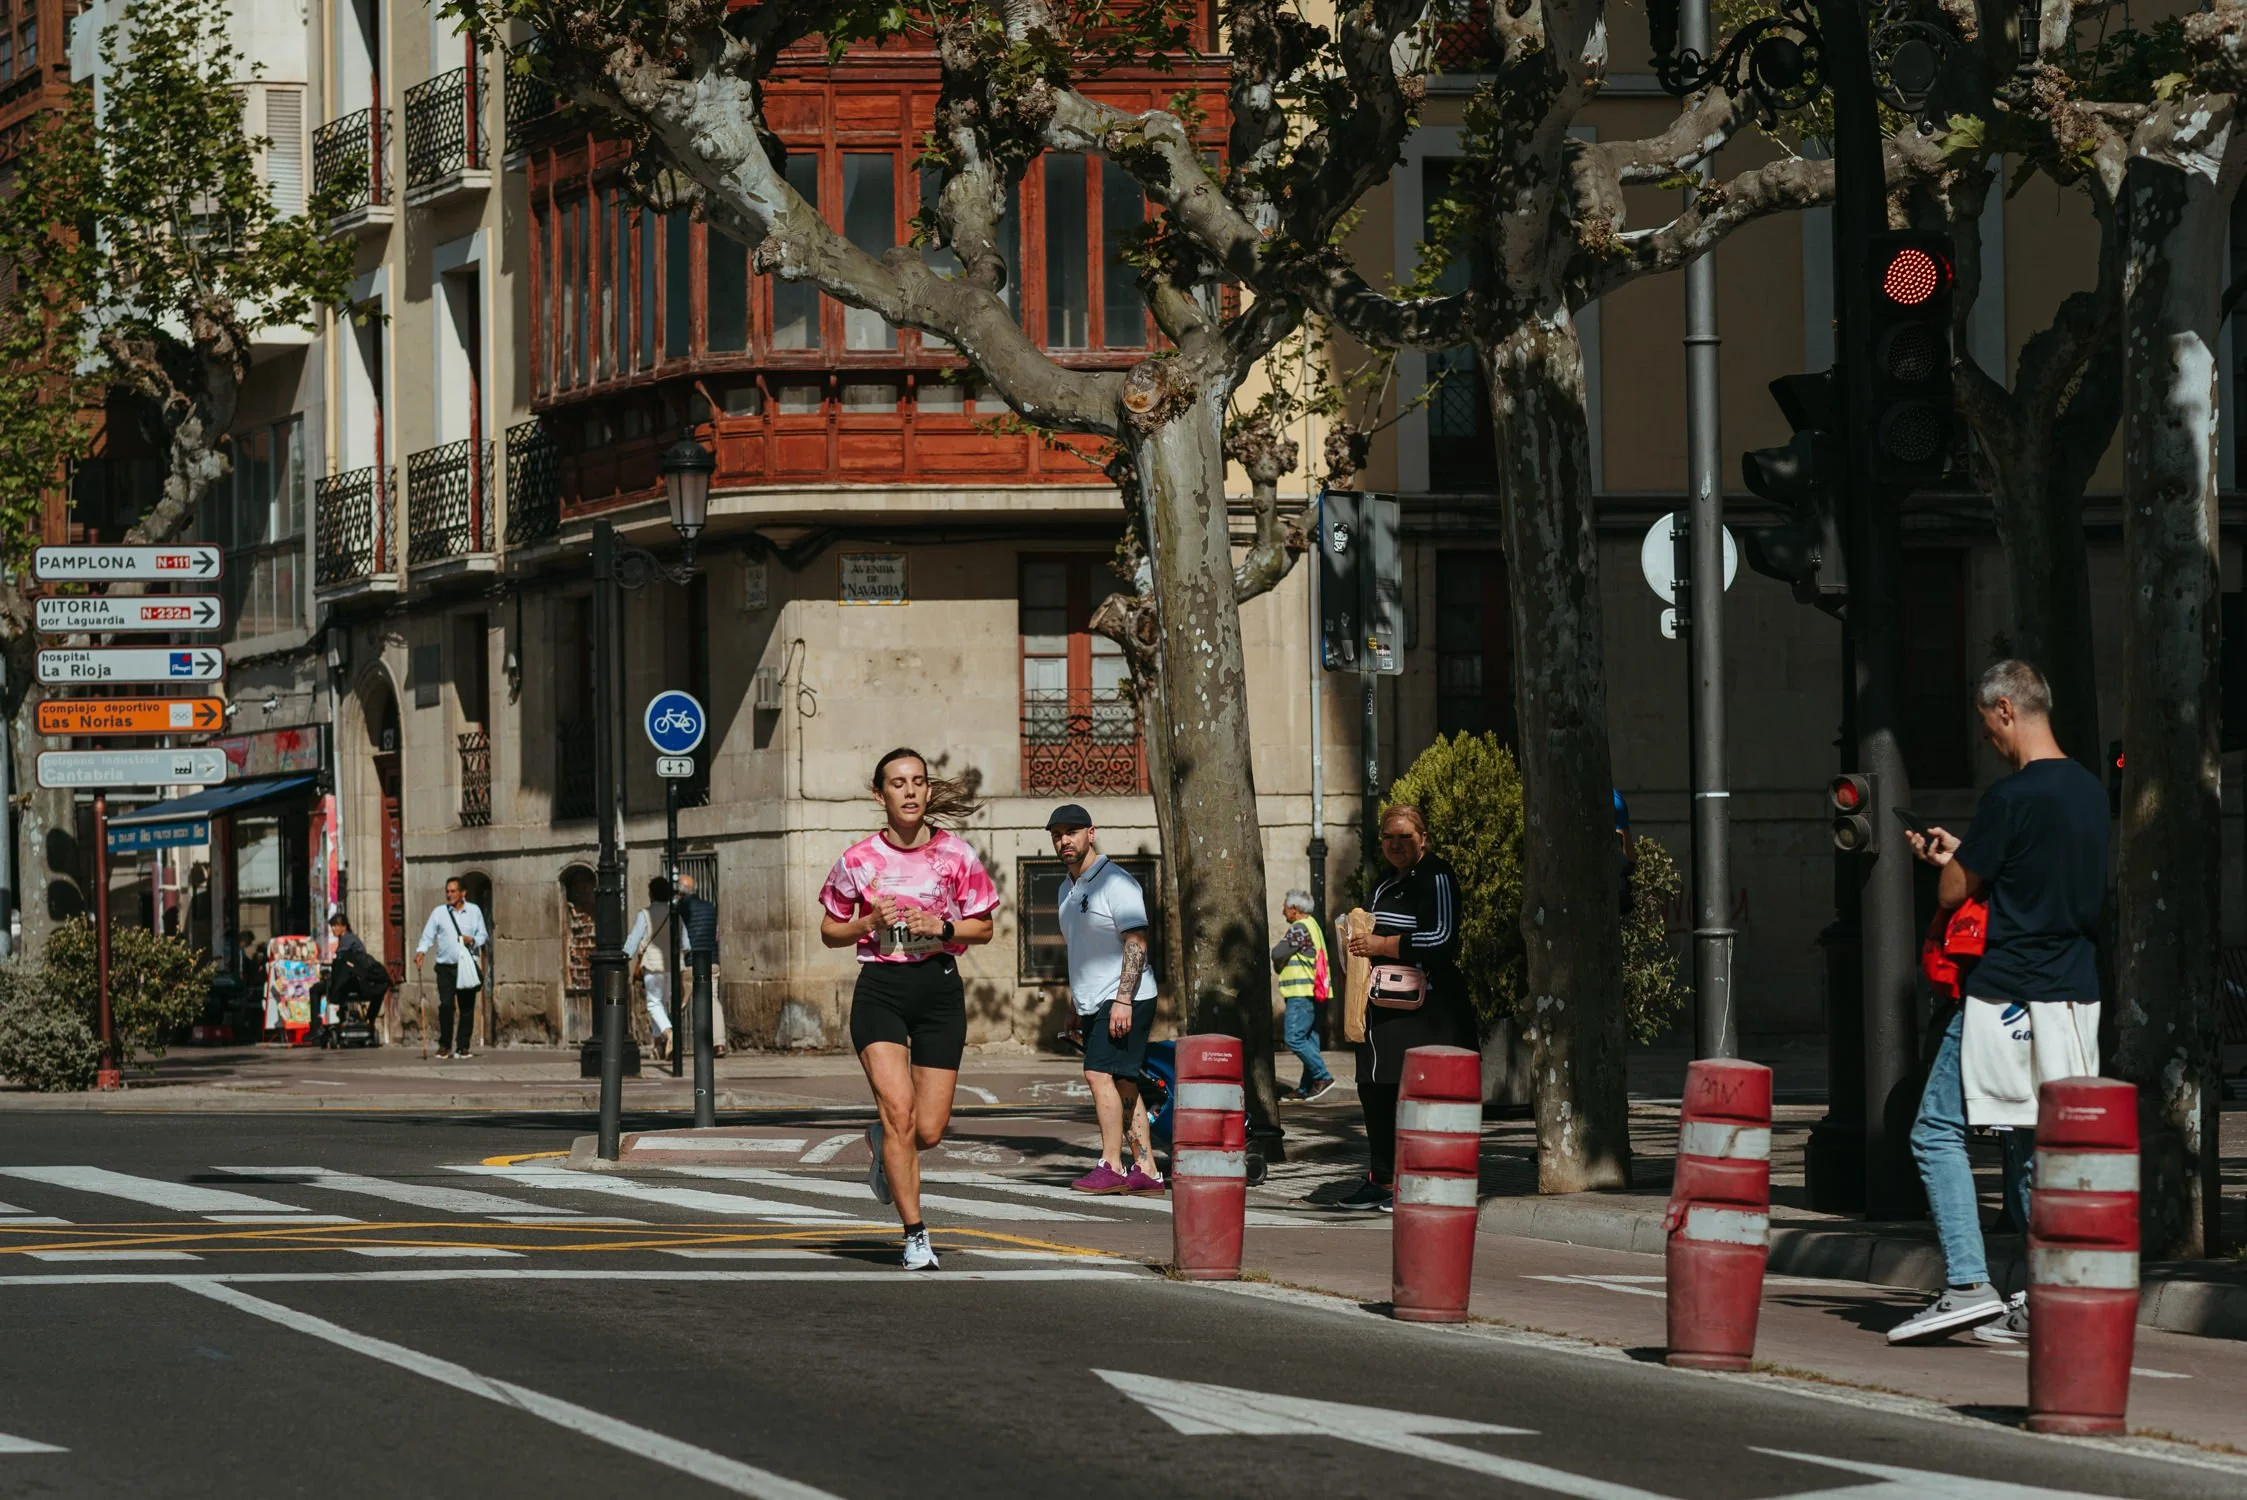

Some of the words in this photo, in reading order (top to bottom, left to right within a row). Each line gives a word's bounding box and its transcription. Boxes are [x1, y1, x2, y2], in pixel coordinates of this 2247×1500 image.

[40, 556, 136, 569] PAMPLONA
[157, 557, 189, 568] N-111
[851, 564, 895, 574] AVENIDA
[867, 575, 878, 583] DE
[847, 584, 900, 597] NAVARRA
[41, 601, 110, 613] VITORIA
[41, 618, 60, 627] por
[67, 616, 125, 627] Laguardia
[42, 652, 90, 662] hospital
[42, 665, 60, 677] La
[71, 663, 112, 678] Rioja
[42, 705, 97, 714] complejo
[104, 703, 160, 713] deportivo
[42, 717, 70, 729] Las
[80, 715, 133, 728] Norias
[101, 754, 160, 765] industrial
[44, 768, 125, 782] Cantabria
